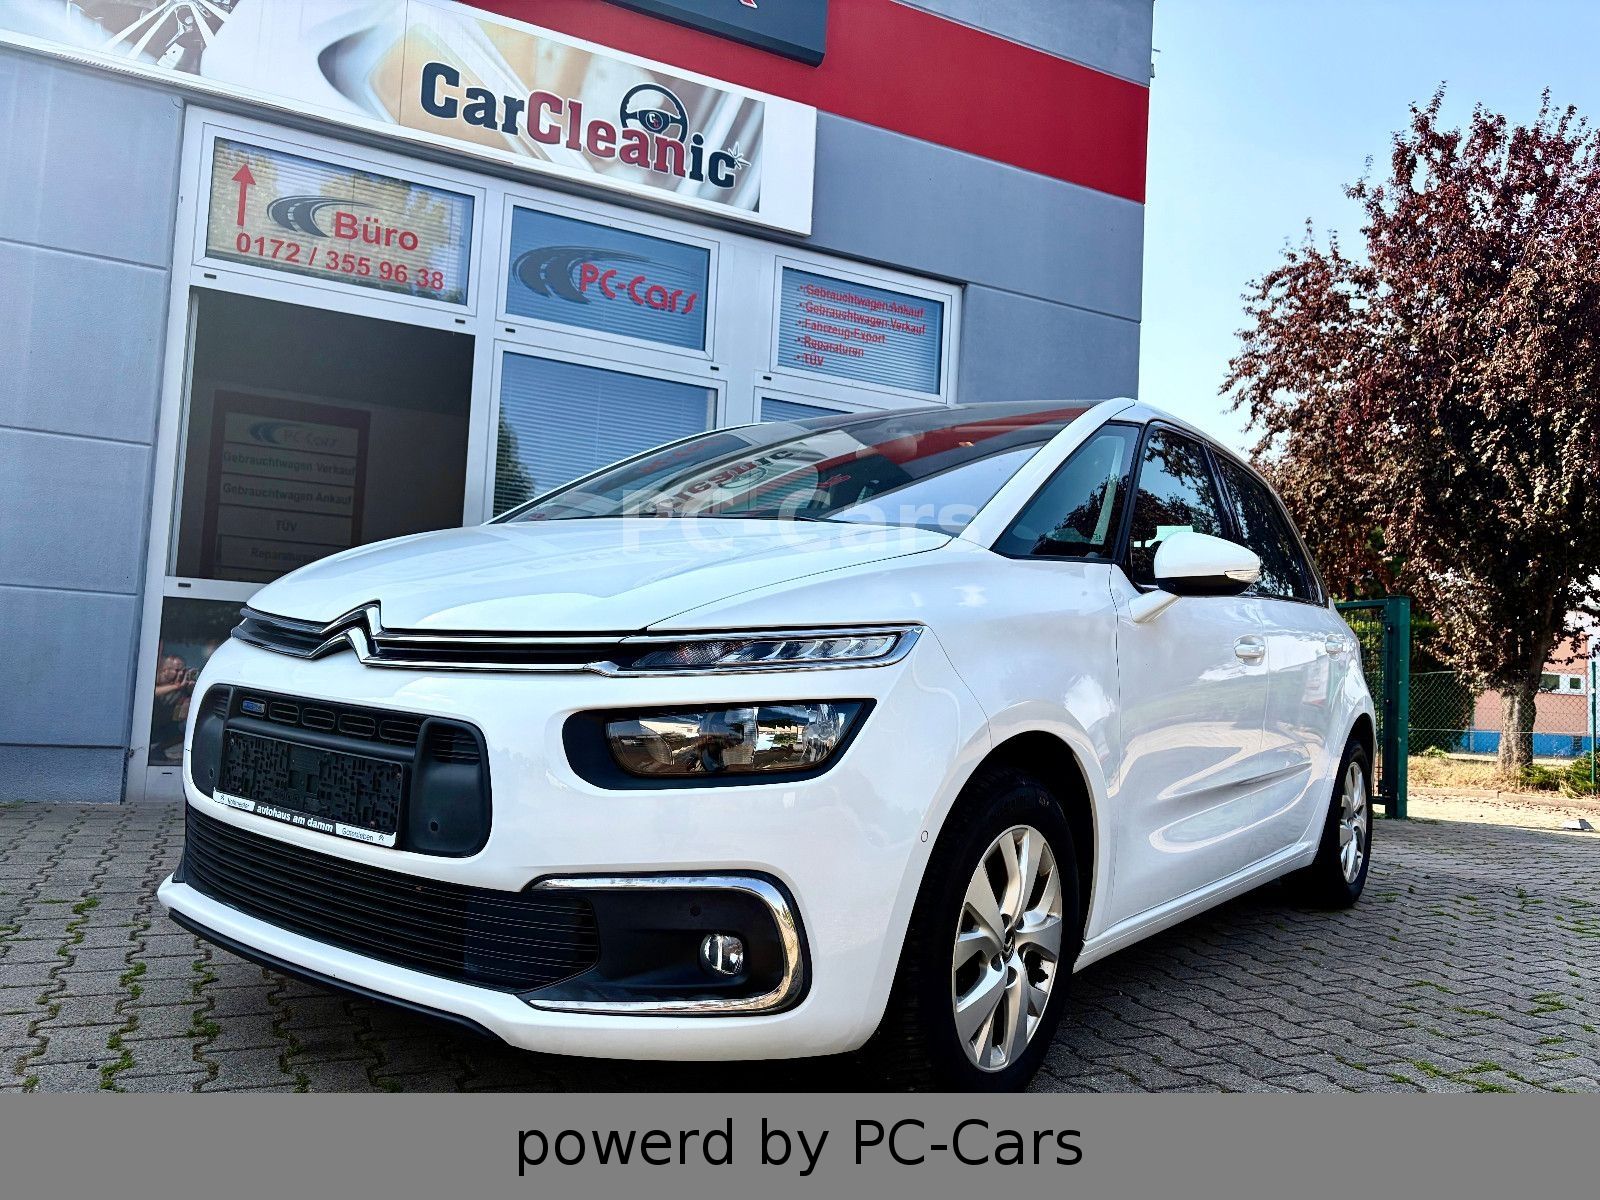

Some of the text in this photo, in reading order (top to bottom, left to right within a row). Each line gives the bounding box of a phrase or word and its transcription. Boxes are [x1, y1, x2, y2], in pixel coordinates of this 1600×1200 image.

[420, 62, 736, 189] CarCleanic
[334, 211, 419, 251] Büro
[236, 233, 301, 264] 0172
[325, 250, 371, 276] 355
[379, 261, 408, 283] 96
[416, 268, 445, 290] 38
[580, 263, 698, 314] PC-Cars
[803, 335, 865, 357] Reparaturen
[803, 351, 825, 366] TÜV
[223, 452, 313, 472] Gebrauchtwagen
[223, 483, 352, 506] Gebrauchtwagen Ankauf
[276, 518, 298, 532] TÜV
[256, 804, 334, 833] autohaus am damm
